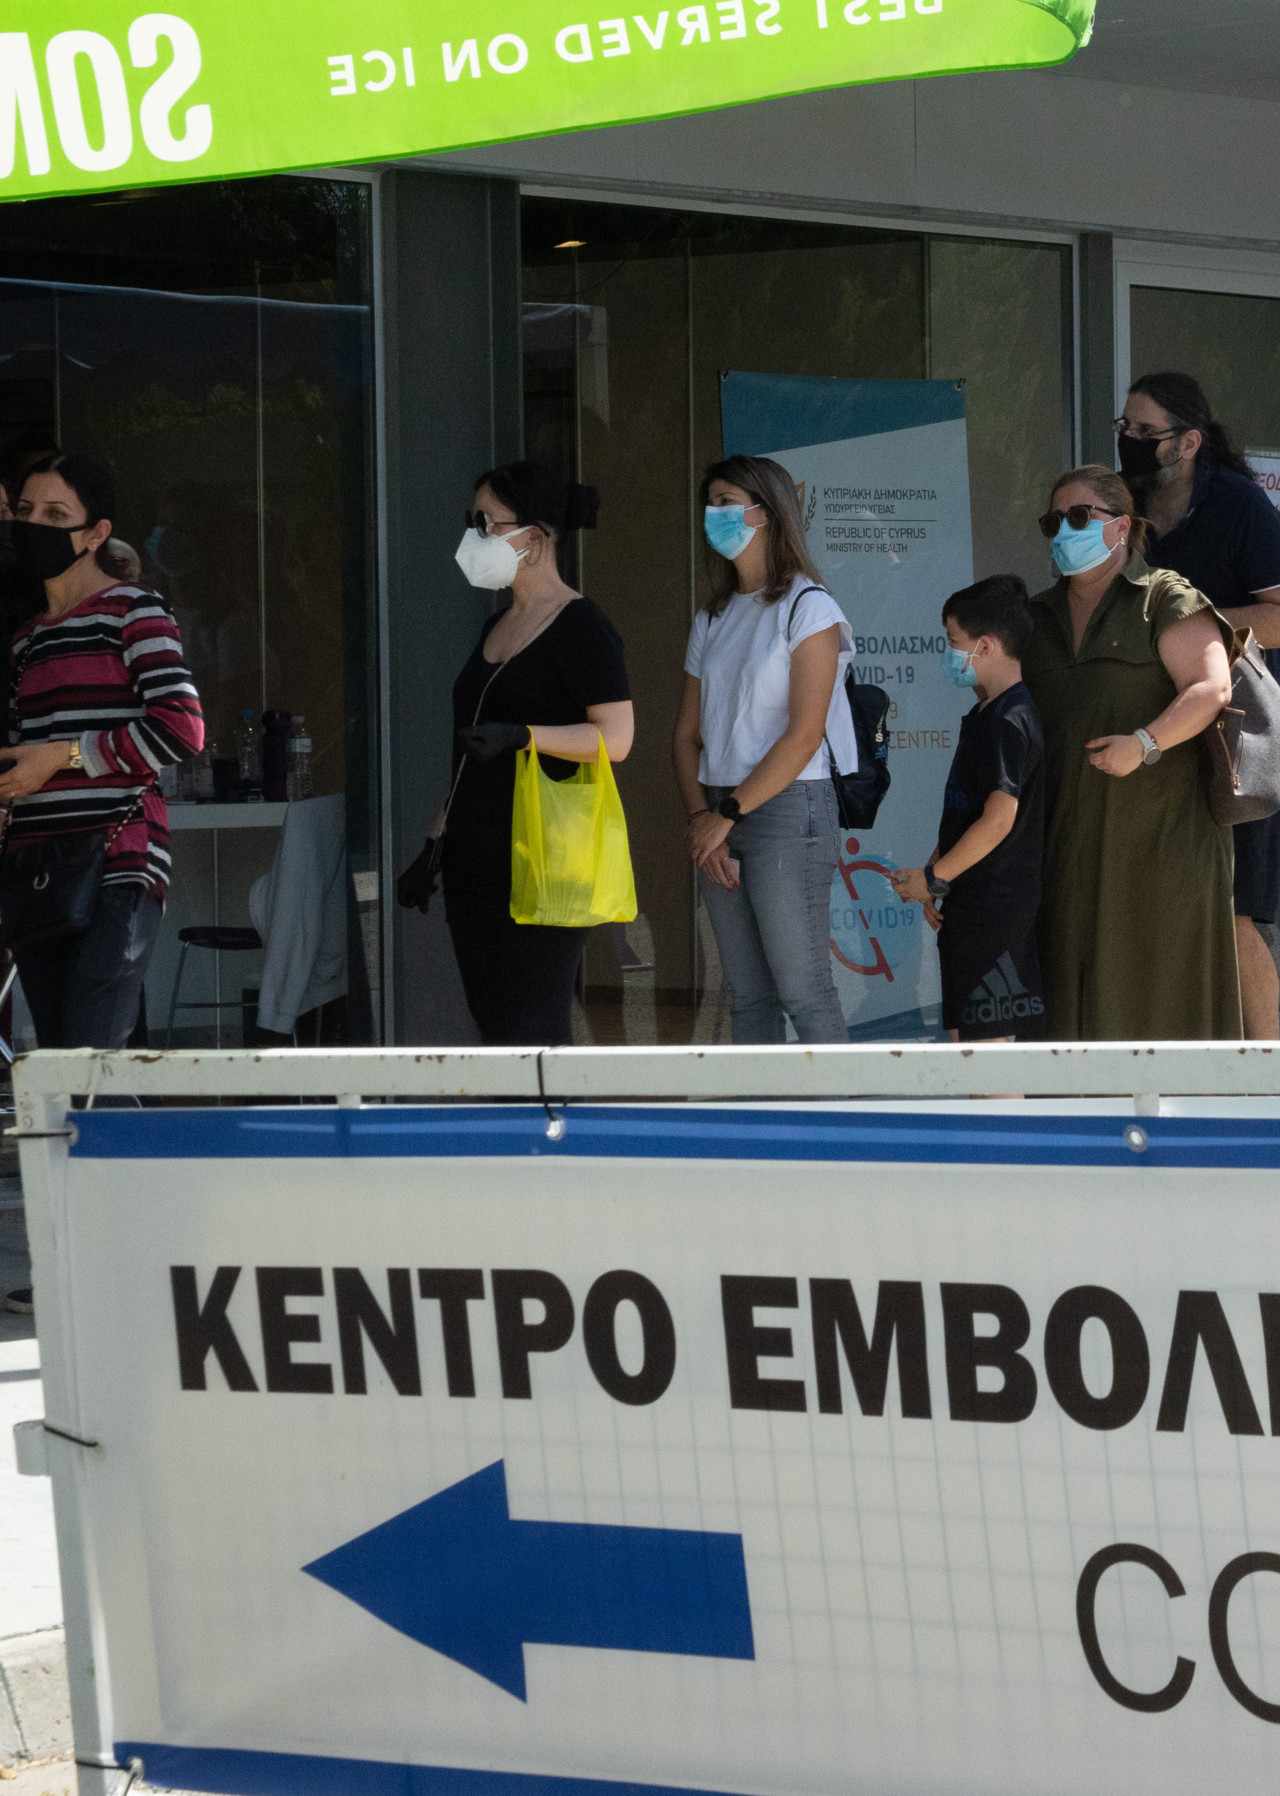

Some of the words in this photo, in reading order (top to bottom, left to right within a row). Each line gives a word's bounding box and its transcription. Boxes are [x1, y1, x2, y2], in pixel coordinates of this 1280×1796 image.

[823, 487, 872, 499] ΚΥΠΡΙΑΚΗ
[873, 488, 937, 500] ΔΗΜΟΚΡΑΤΙΑ
[825, 526, 871, 539] REPUBLIC
[874, 527, 886, 539] OF
[888, 528, 926, 539] CYPRUS
[826, 543, 861, 553] MINISTRY
[864, 543, 875, 553] OF
[876, 543, 908, 553] HEALTH
[855, 636, 946, 655] ΒΟΛΙΑΣΜΟ
[856, 666, 914, 684] VID-19
[962, 995, 1045, 1024] adidas
[170, 1265, 676, 1405] ΚΕΝΤΡΟ
